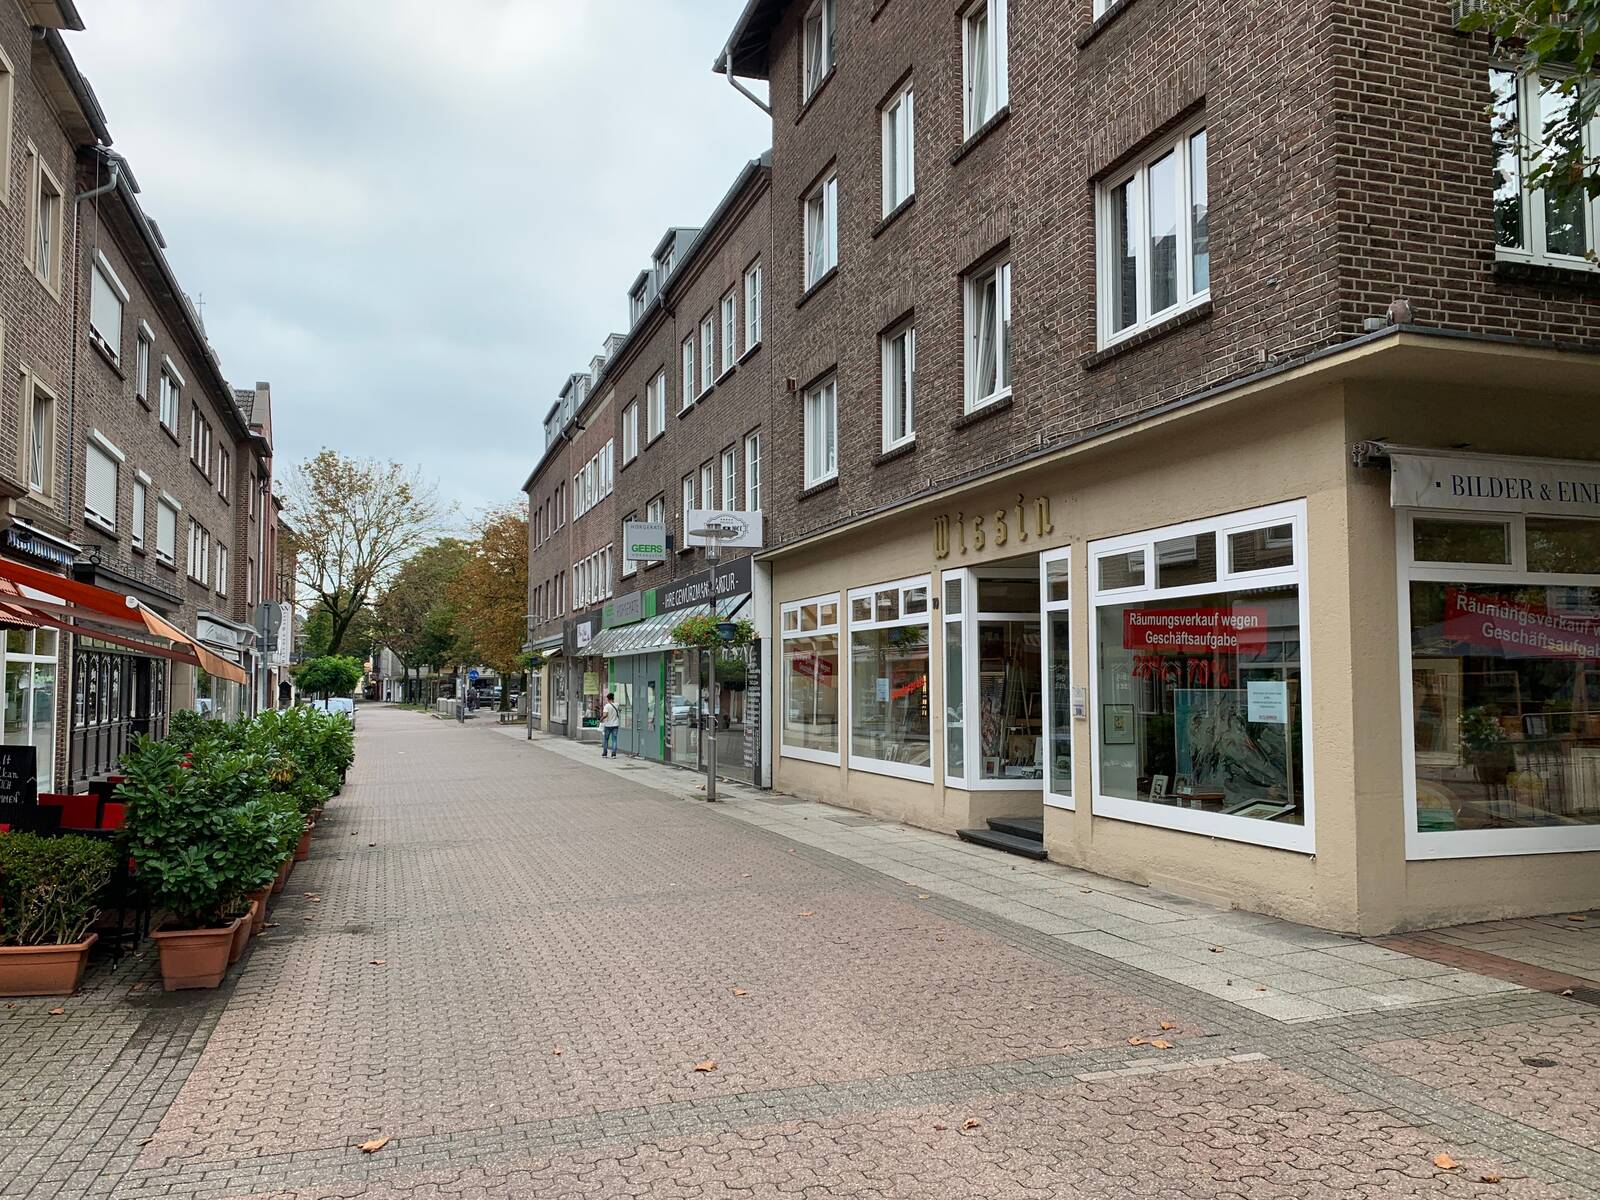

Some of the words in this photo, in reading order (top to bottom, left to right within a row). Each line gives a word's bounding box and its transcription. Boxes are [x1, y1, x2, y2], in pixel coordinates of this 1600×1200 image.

[1450, 474, 1535, 500] BILDER
[1540, 483, 1552, 500] &
[934, 493, 1054, 559] Wissin
[631, 544, 663, 553] GEERS
[665, 591, 676, 609] IHRE
[675, 572, 735, 606] GEWÜRZMANAKTUR
[1129, 612, 1219, 629] Räumungsverkauf
[1221, 613, 1258, 630] wegen
[1457, 594, 1590, 635] Räumungsverkauf
[1145, 631, 1238, 650] Geschäftsaufgabe
